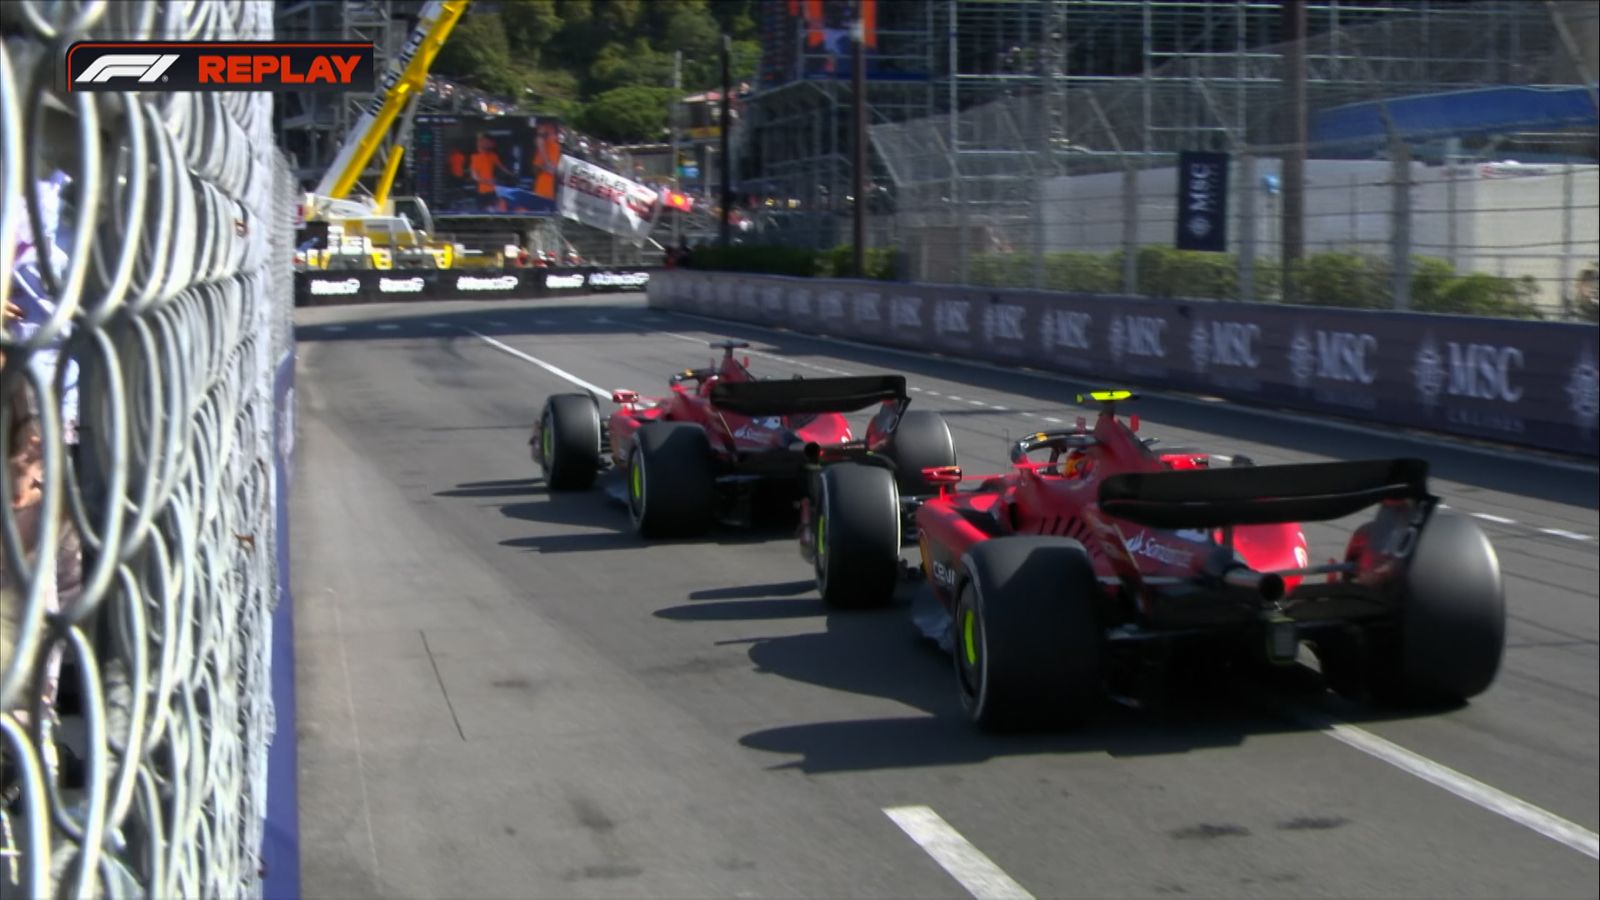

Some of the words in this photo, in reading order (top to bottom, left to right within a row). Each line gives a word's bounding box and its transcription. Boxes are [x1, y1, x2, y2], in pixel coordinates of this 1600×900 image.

[1211, 321, 1262, 368] MSC
[1315, 331, 1379, 385] MSC
[1447, 342, 1525, 403] MSC
